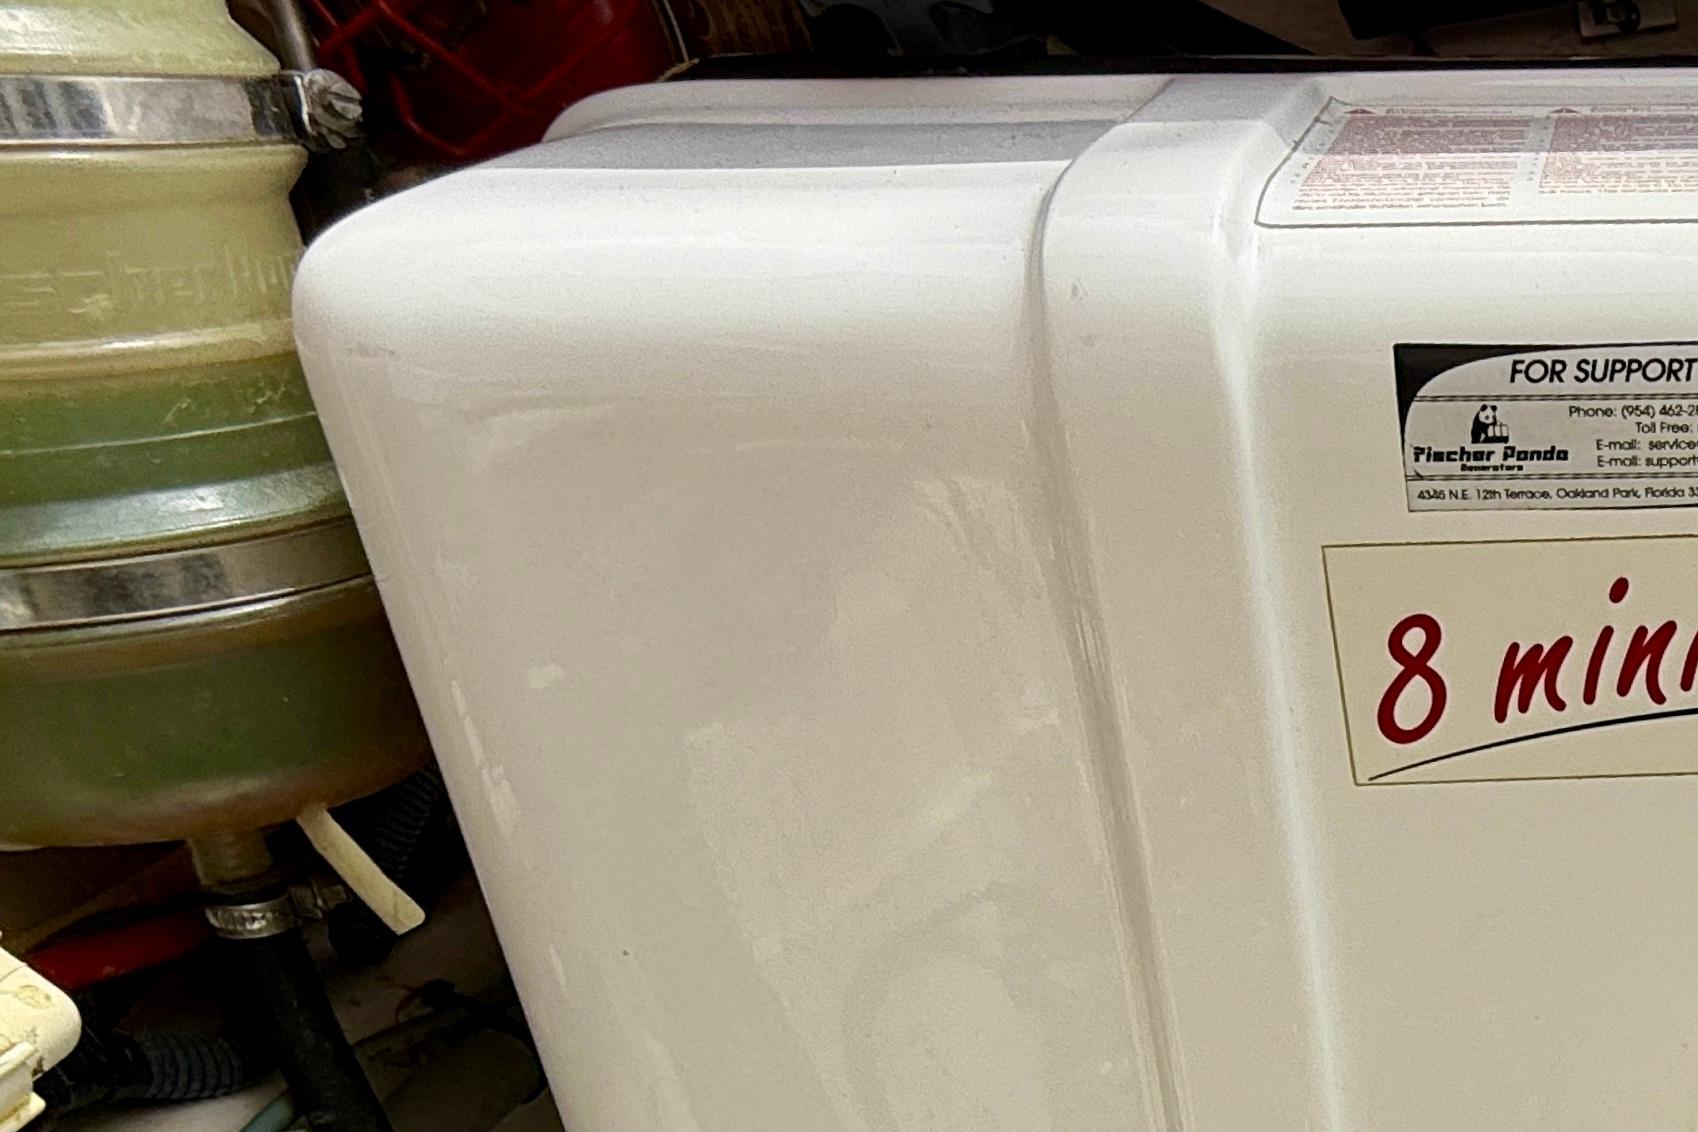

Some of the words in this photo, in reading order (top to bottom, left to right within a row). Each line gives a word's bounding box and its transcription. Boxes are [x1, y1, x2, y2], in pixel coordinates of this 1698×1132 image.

[1509, 360, 1568, 384] FOR
[1574, 357, 1698, 384] SUPPORT
[1568, 405, 1617, 418] Phone:
[1621, 404, 1656, 419] (954)
[1635, 421, 1657, 433] Toll
[1660, 421, 1693, 433] Free:
[1596, 439, 1640, 451] E-mail:
[1413, 446, 1496, 463] Fischer
[1502, 445, 1569, 462] Panda
[1460, 464, 1524, 472] Generators
[1597, 455, 1641, 468] E-mail:
[1476, 488, 1501, 500] 12th
[1556, 487, 1609, 499] Oakland
[1612, 486, 1641, 499] Park,
[1645, 486, 1685, 498] Florida
[1377, 613, 1448, 744] 8
